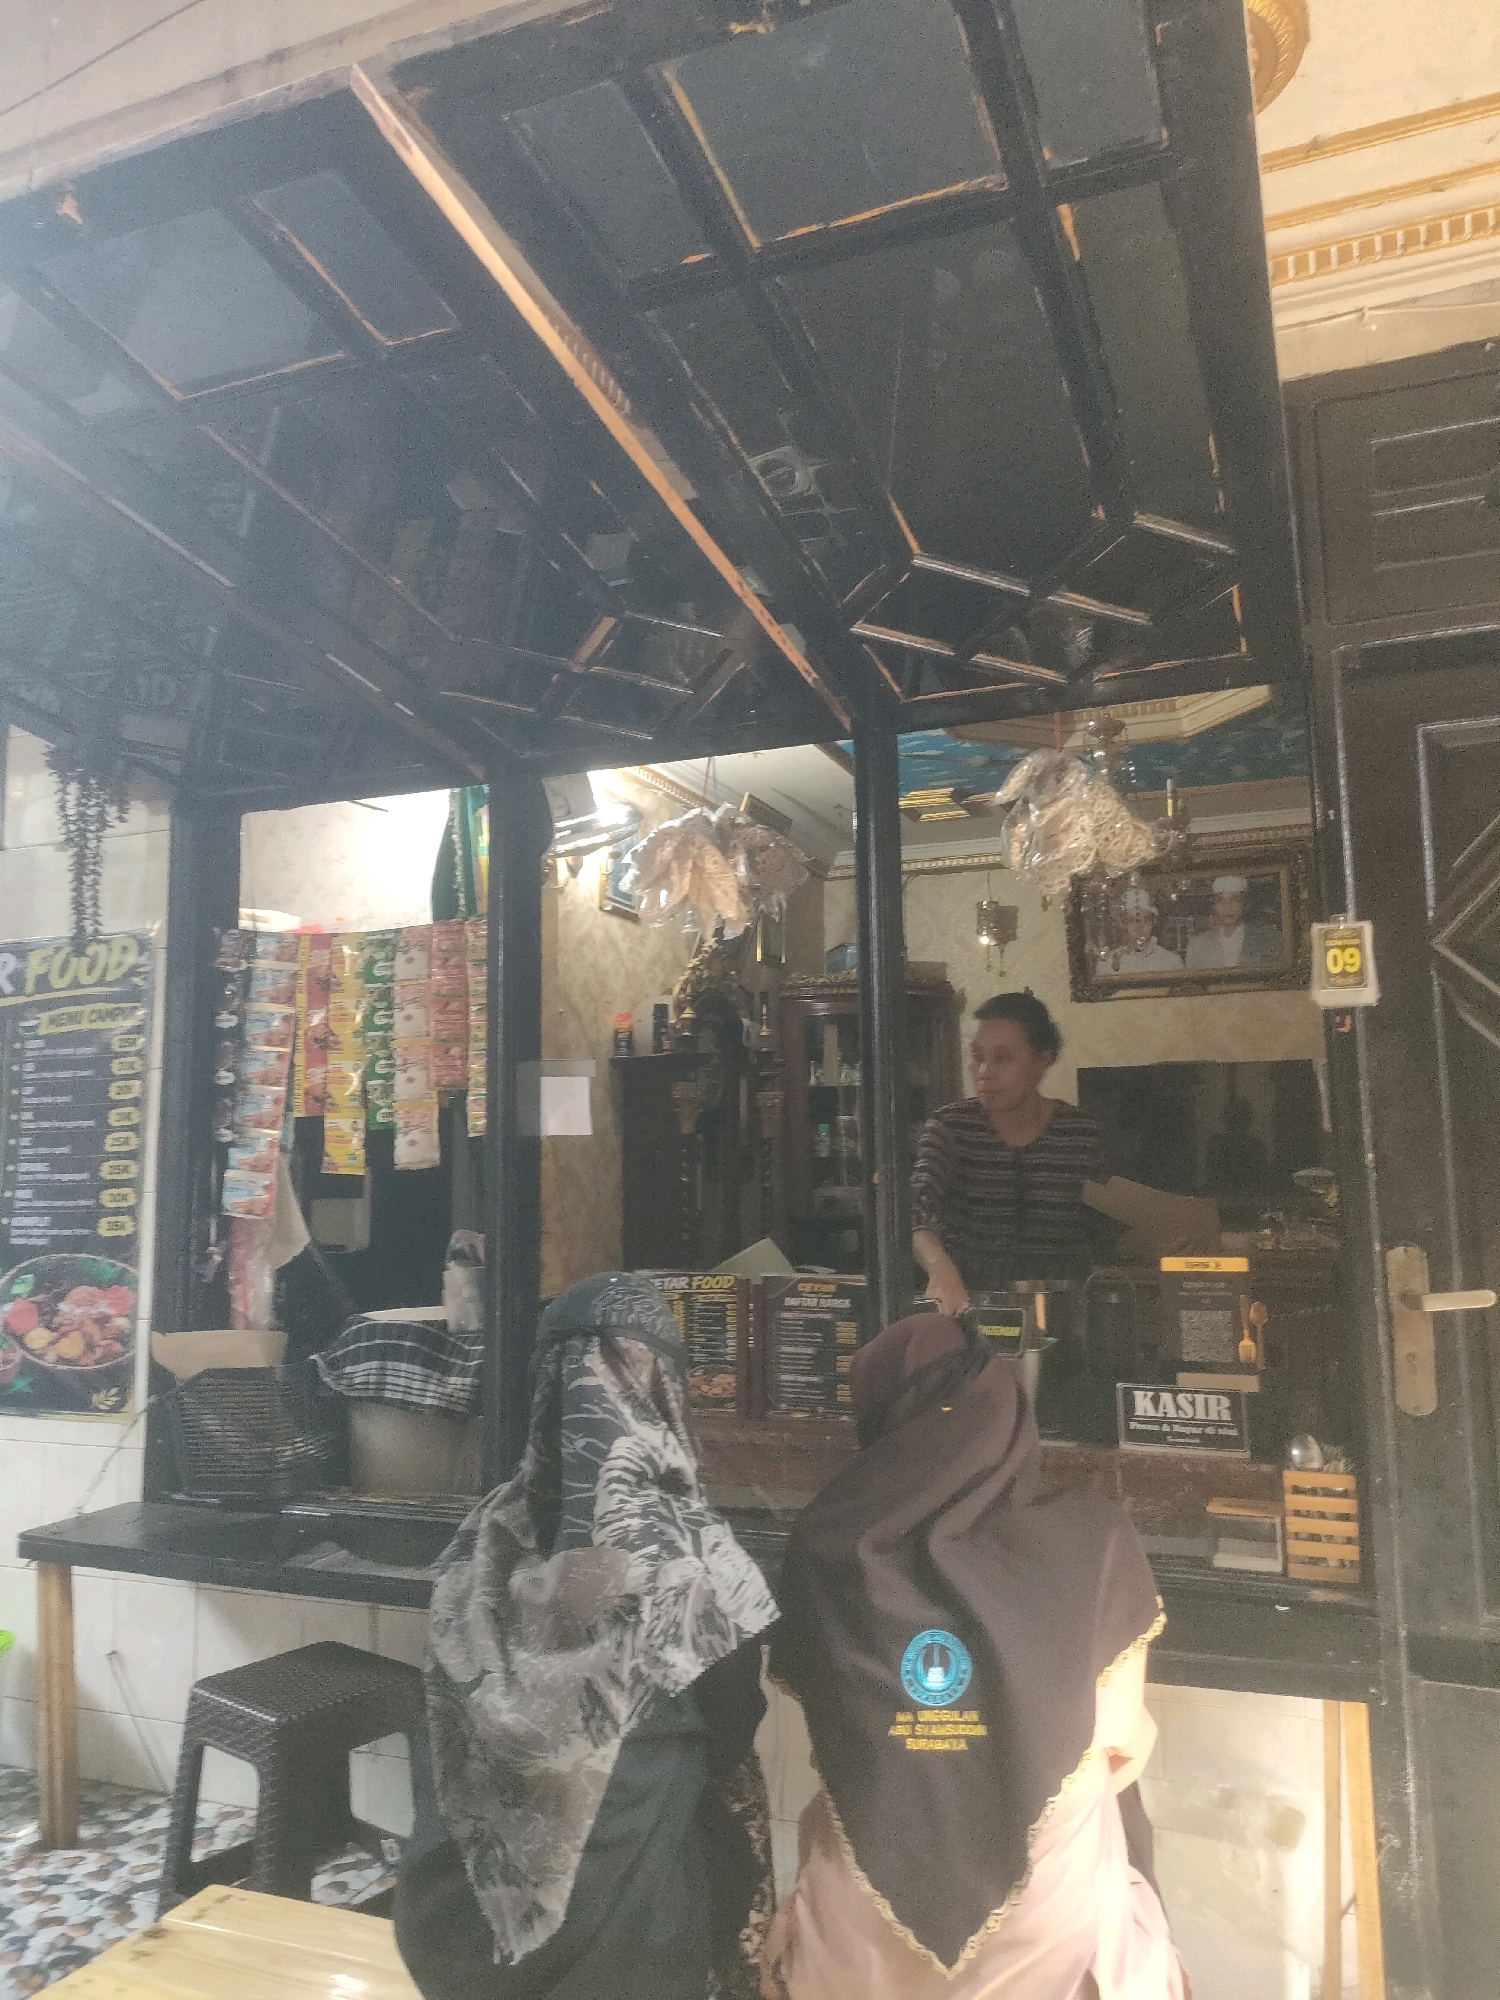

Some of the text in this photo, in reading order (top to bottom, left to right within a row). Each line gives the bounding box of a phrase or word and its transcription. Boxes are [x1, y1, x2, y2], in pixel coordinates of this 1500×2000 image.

[25, 936, 139, 997] FOOD
[1327, 947, 1361, 974] 09
[652, 1276, 736, 1290] ETAR FOOD
[1133, 1390, 1231, 1420] KASIR
[917, 1710, 979, 1721] UNGGULAN
[905, 1738, 968, 1750] SURABAYA
